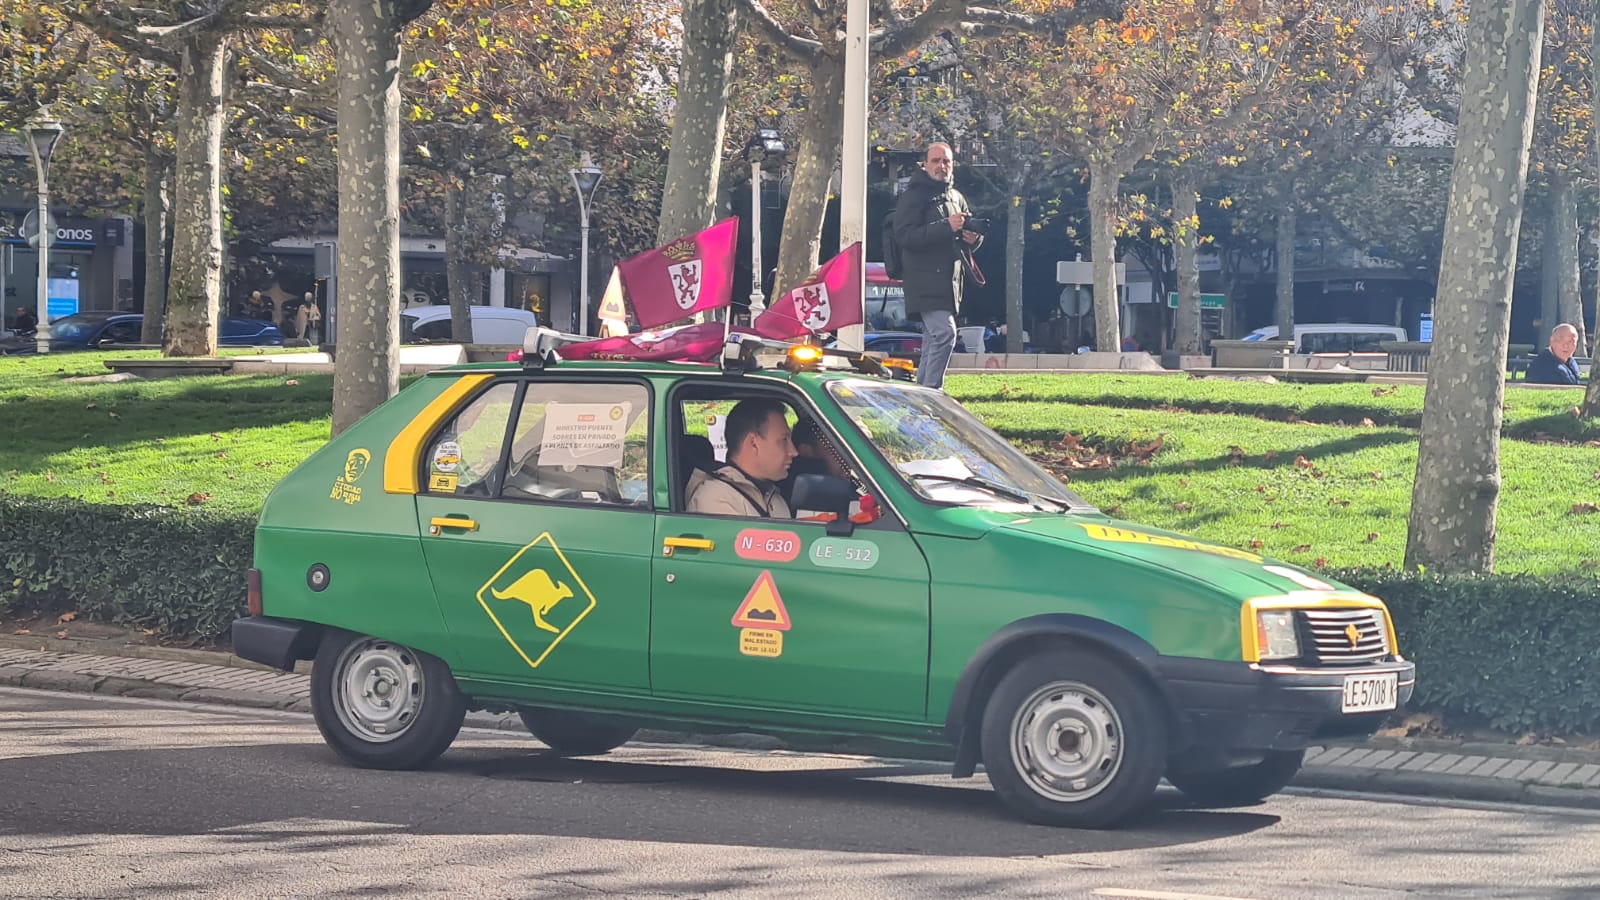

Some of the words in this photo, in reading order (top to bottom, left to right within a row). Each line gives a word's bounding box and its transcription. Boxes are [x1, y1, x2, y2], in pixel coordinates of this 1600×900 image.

[587, 424, 613, 432] PUENTE
[588, 433, 617, 441] PRIVADO
[330, 487, 343, 500] NO
